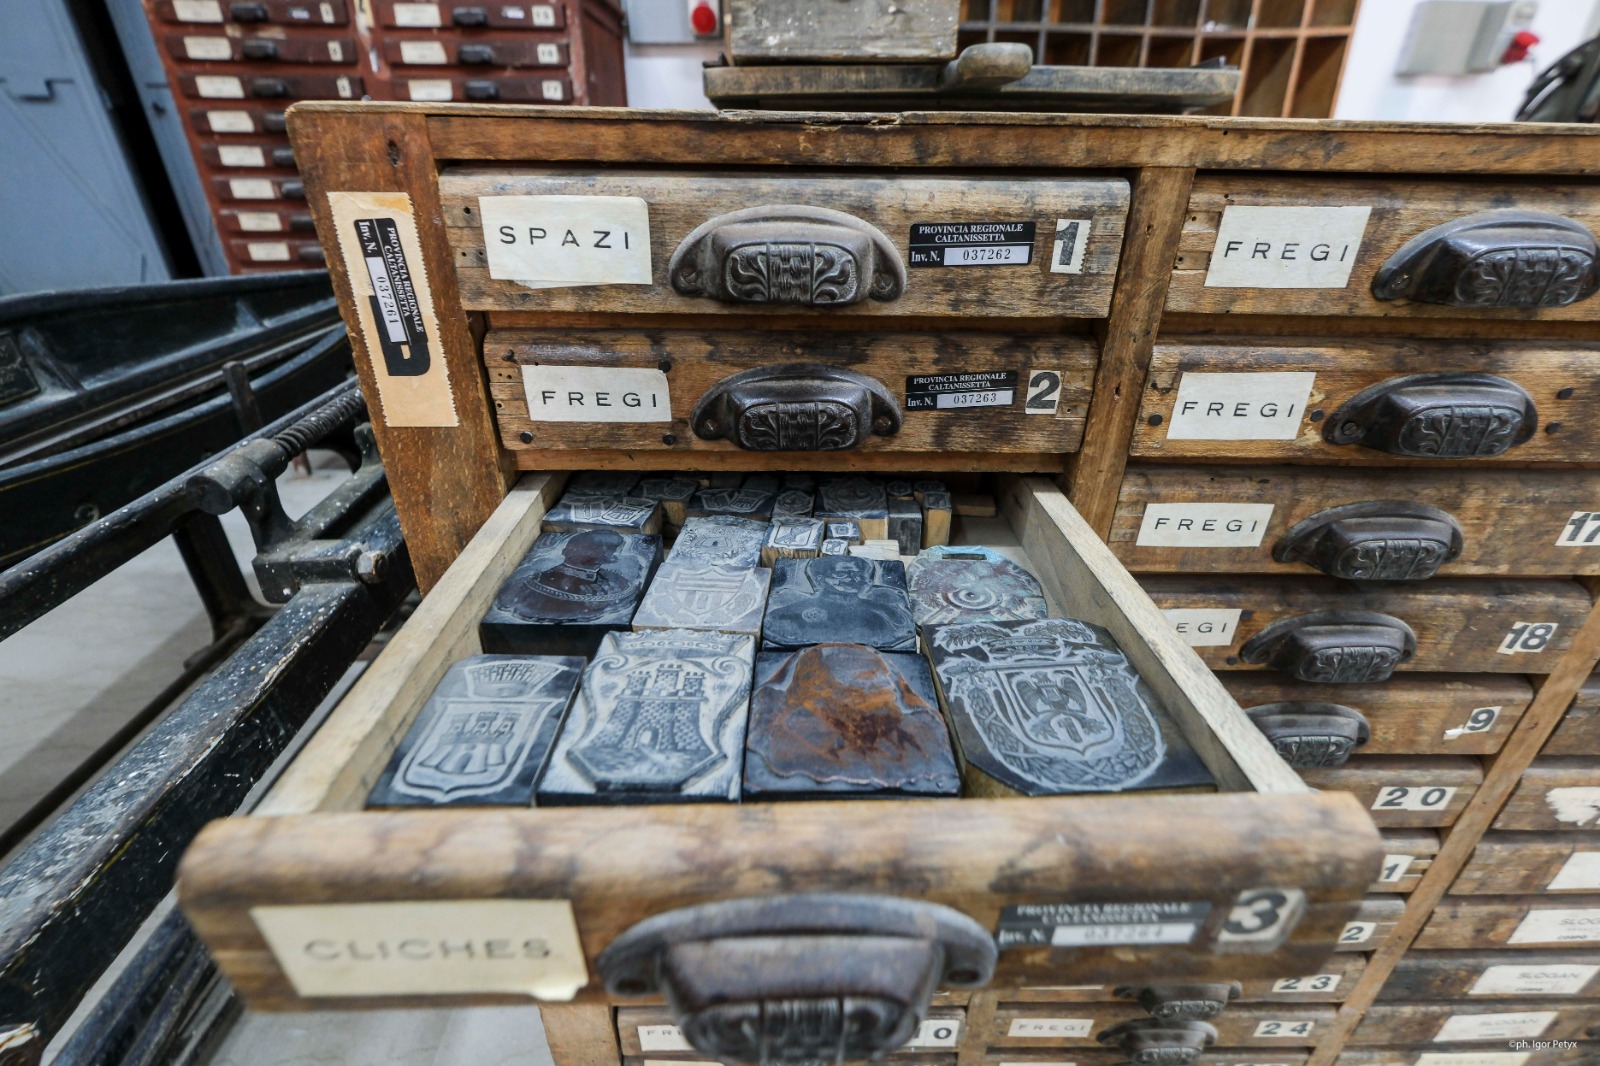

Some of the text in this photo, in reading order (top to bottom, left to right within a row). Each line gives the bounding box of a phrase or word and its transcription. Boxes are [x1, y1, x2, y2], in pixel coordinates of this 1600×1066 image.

[358, 221, 378, 254] Inv. N.
[499, 226, 630, 250] SPAZI
[918, 223, 1024, 235] PROVINCIA REGIONALE
[934, 233, 1006, 244] CALTANISSETTA
[1055, 221, 1080, 266] 1
[1223, 240, 1350, 262] FREGI
[911, 250, 941, 262] Inv. N.
[962, 248, 1012, 261] 037262
[384, 245, 411, 318] CALTANISSETTA
[386, 227, 424, 333] PROVINCIA REGIONALE
[376, 276, 400, 325] 037261
[913, 372, 1007, 385] PROVINCIA REGIONALE
[928, 381, 992, 391] CALTANISSETTA
[541, 390, 658, 409] FREGI
[953, 393, 998, 405] 037263
[1026, 371, 1061, 410] 2
[907, 396, 934, 407] Inv. N.
[1181, 400, 1295, 418] FREGI
[1154, 517, 1258, 533] FREGI
[1565, 512, 1600, 543] 17
[1505, 624, 1553, 651] 18
[1379, 786, 1447, 807] 20
[1223, 890, 1288, 935] 3
[303, 937, 553, 961] CLICHES
[1279, 974, 1332, 990] 23
[1260, 1022, 1309, 1035] 24
